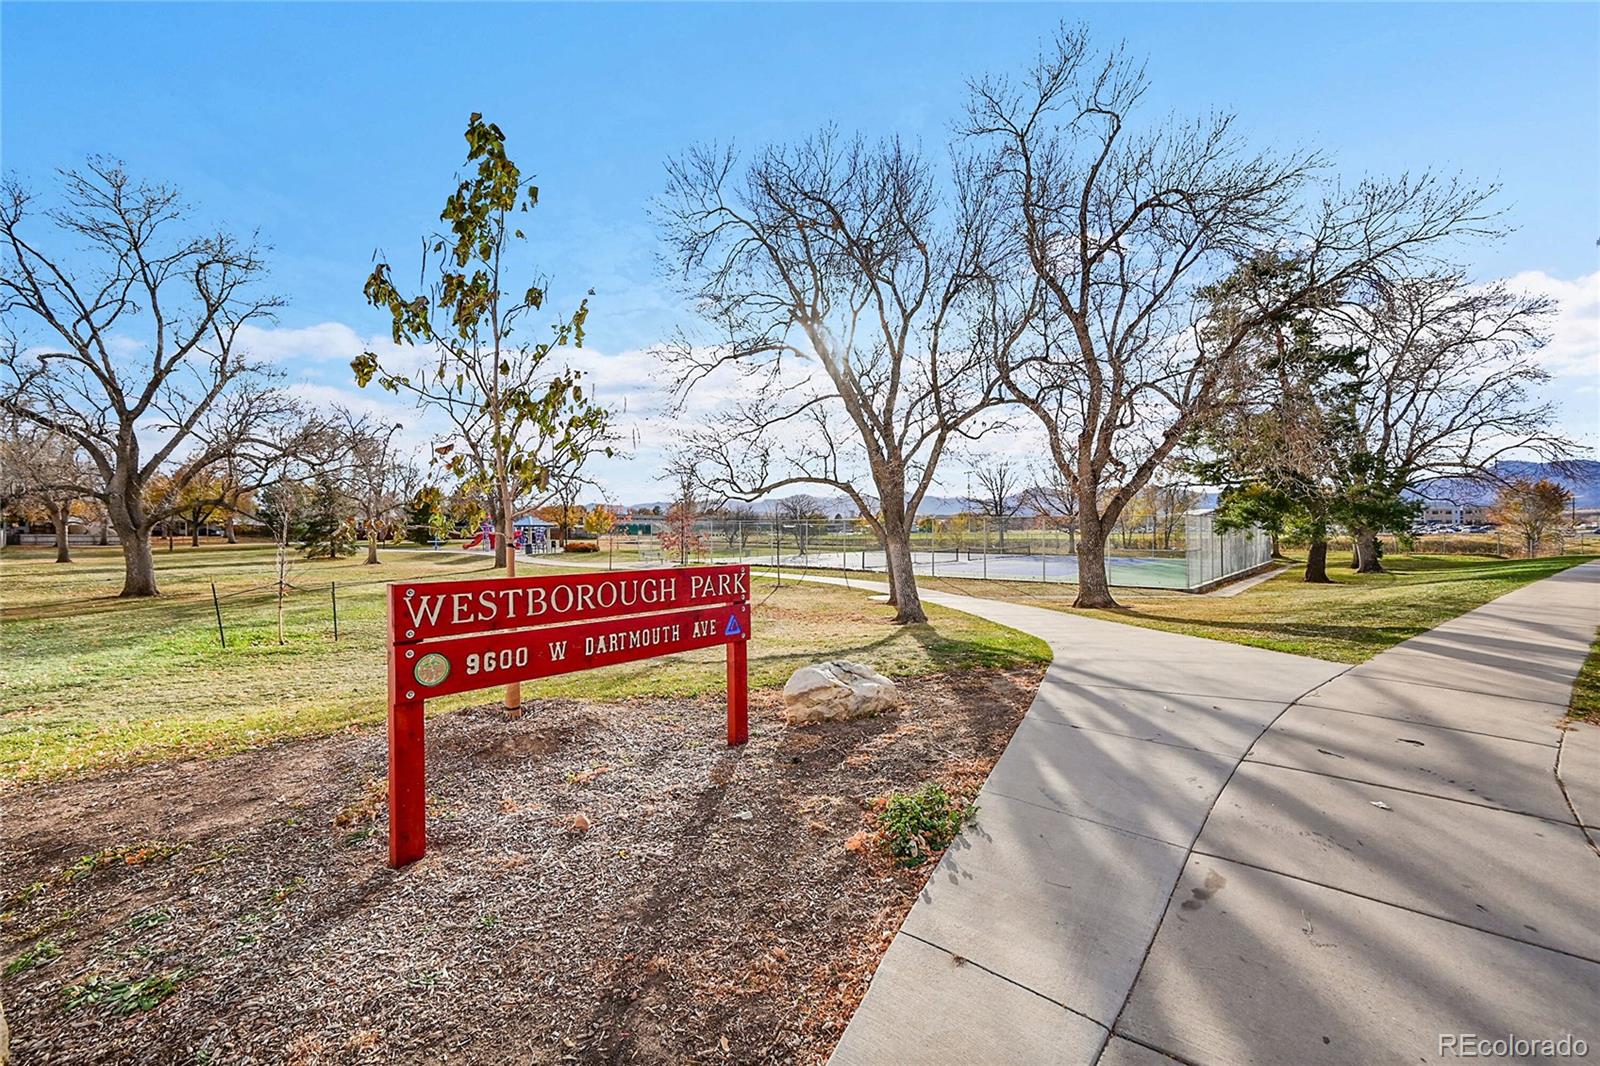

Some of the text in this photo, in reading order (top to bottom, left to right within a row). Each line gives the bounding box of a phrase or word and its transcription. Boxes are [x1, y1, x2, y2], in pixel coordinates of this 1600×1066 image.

[404, 572, 747, 628] WESTBOROUGH PARK
[466, 619, 718, 675] 9600 W DARTMOUTH AVE
